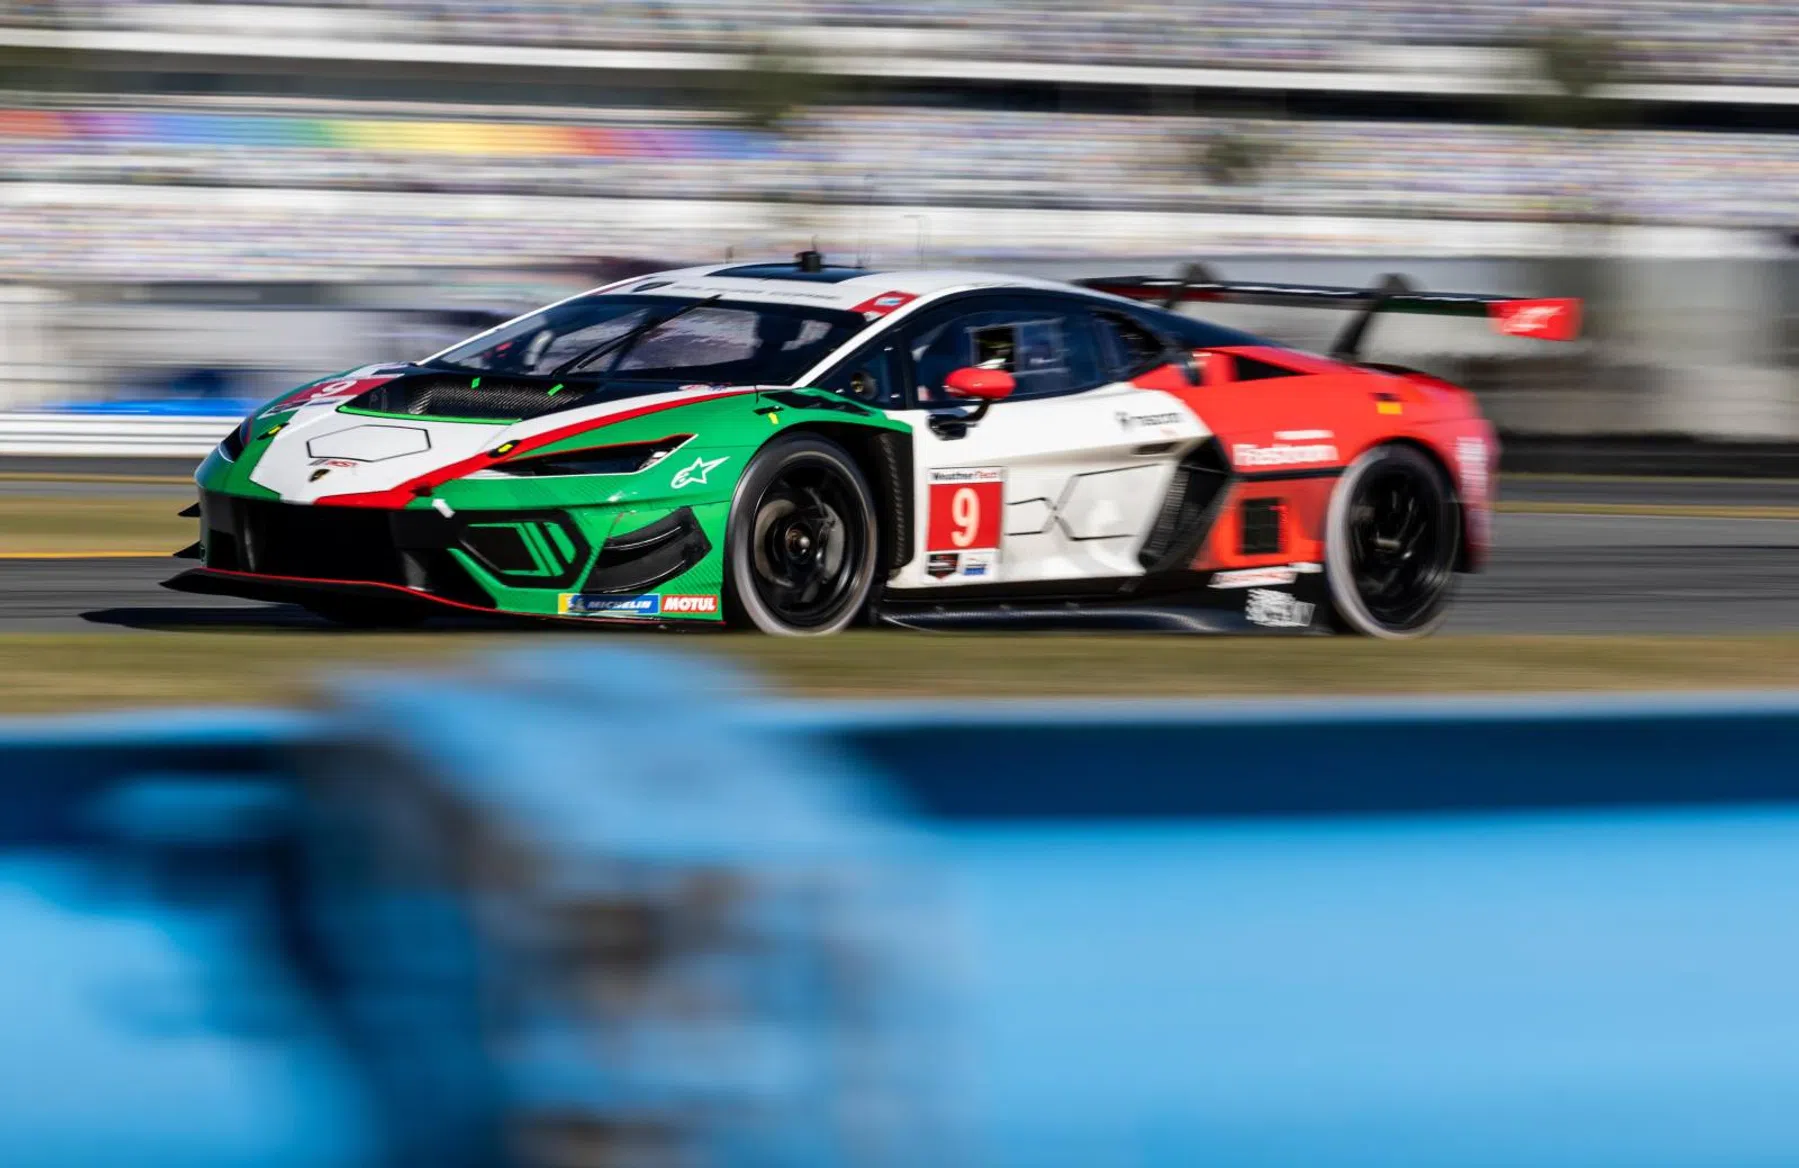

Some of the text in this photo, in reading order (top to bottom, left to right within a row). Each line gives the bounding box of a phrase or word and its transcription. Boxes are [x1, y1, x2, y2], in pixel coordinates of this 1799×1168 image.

[311, 380, 357, 399] 9
[951, 487, 980, 548] 9
[587, 600, 652, 610] MICHELIN
[664, 597, 715, 611] MOTUL
